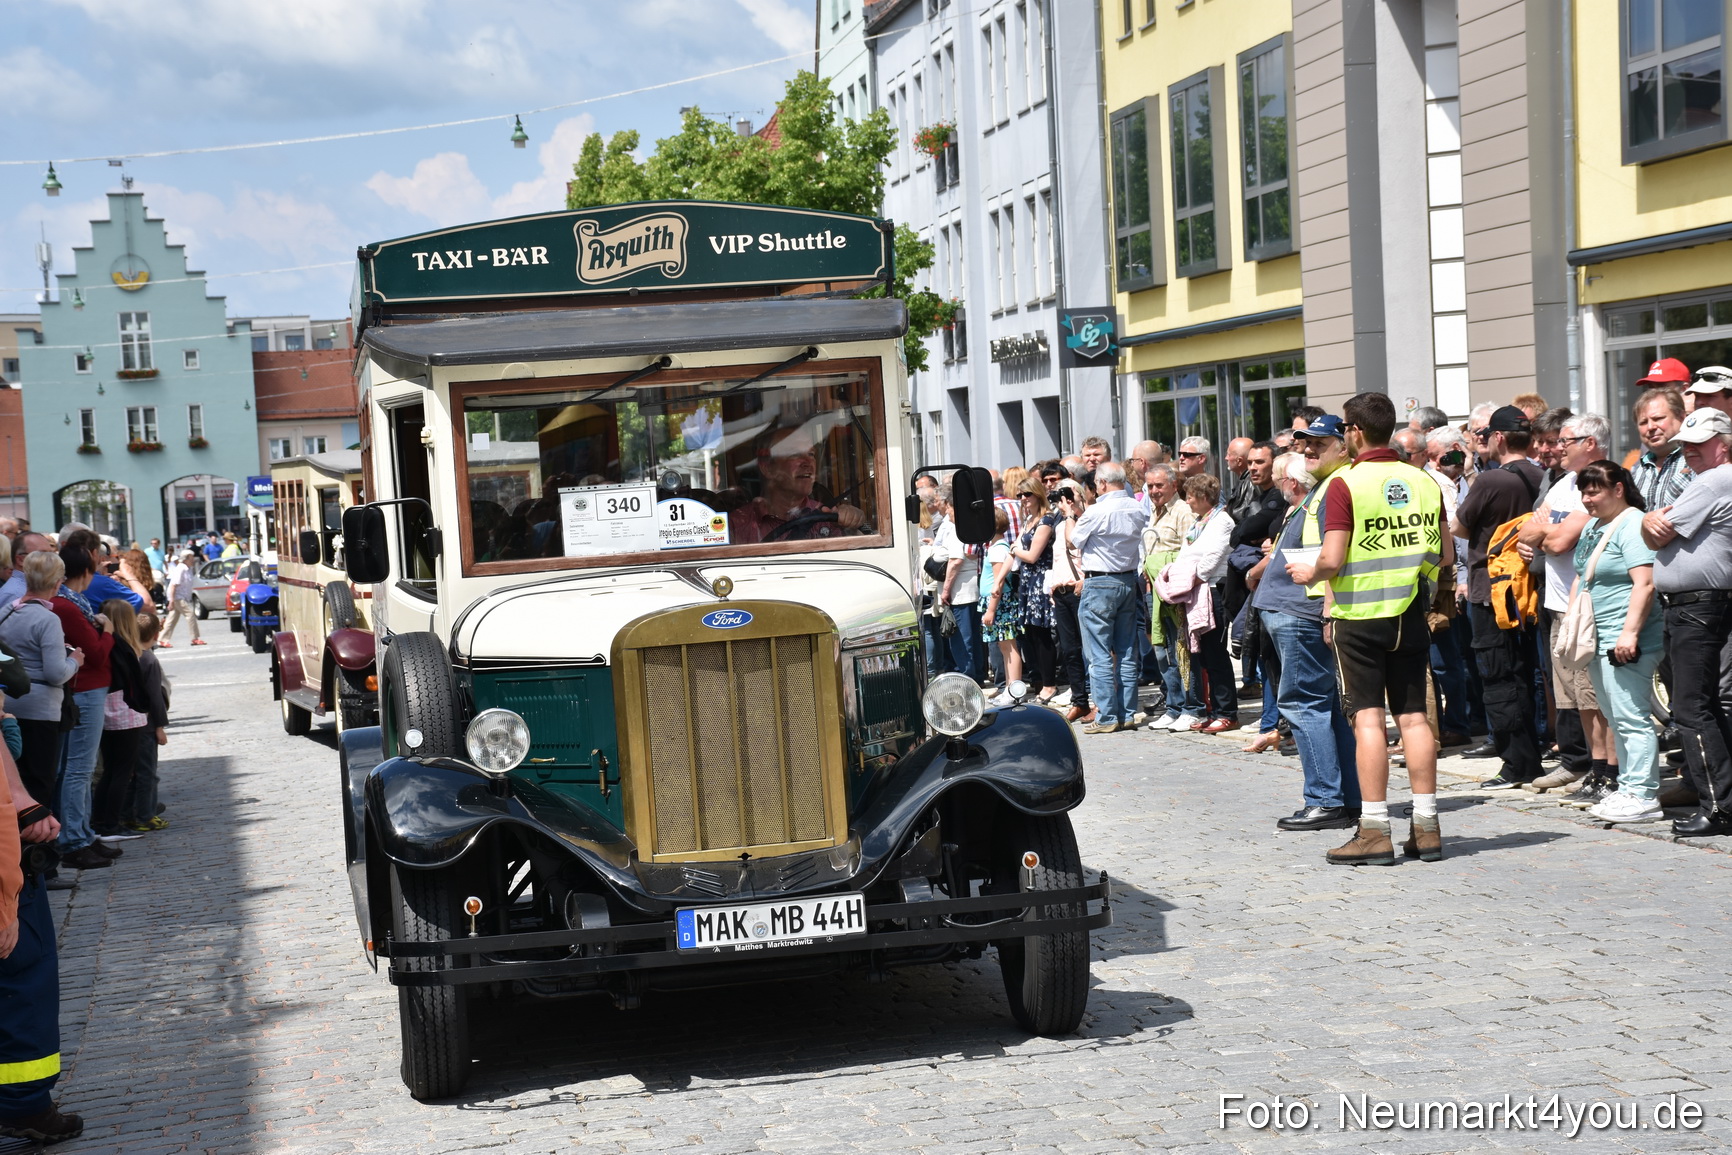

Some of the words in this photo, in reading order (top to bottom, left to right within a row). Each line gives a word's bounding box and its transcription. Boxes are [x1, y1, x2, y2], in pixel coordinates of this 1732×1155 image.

[587, 223, 676, 272] Asquith
[708, 233, 754, 255] VIP
[758, 230, 847, 253] Shuttle
[606, 496, 641, 514] 340
[669, 503, 686, 522] 31
[673, 526, 693, 539] Egrensis
[693, 522, 710, 535] Classic
[1364, 512, 1436, 533] FOLLOW
[1390, 531, 1420, 548] ME
[712, 612, 742, 626] Ford
[696, 909, 749, 943] MAK
[770, 904, 805, 936] MB
[812, 898, 864, 931] 44H
[683, 932, 691, 942] D
[734, 942, 764, 952] Matthes
[766, 938, 814, 949] Marktredwitz
